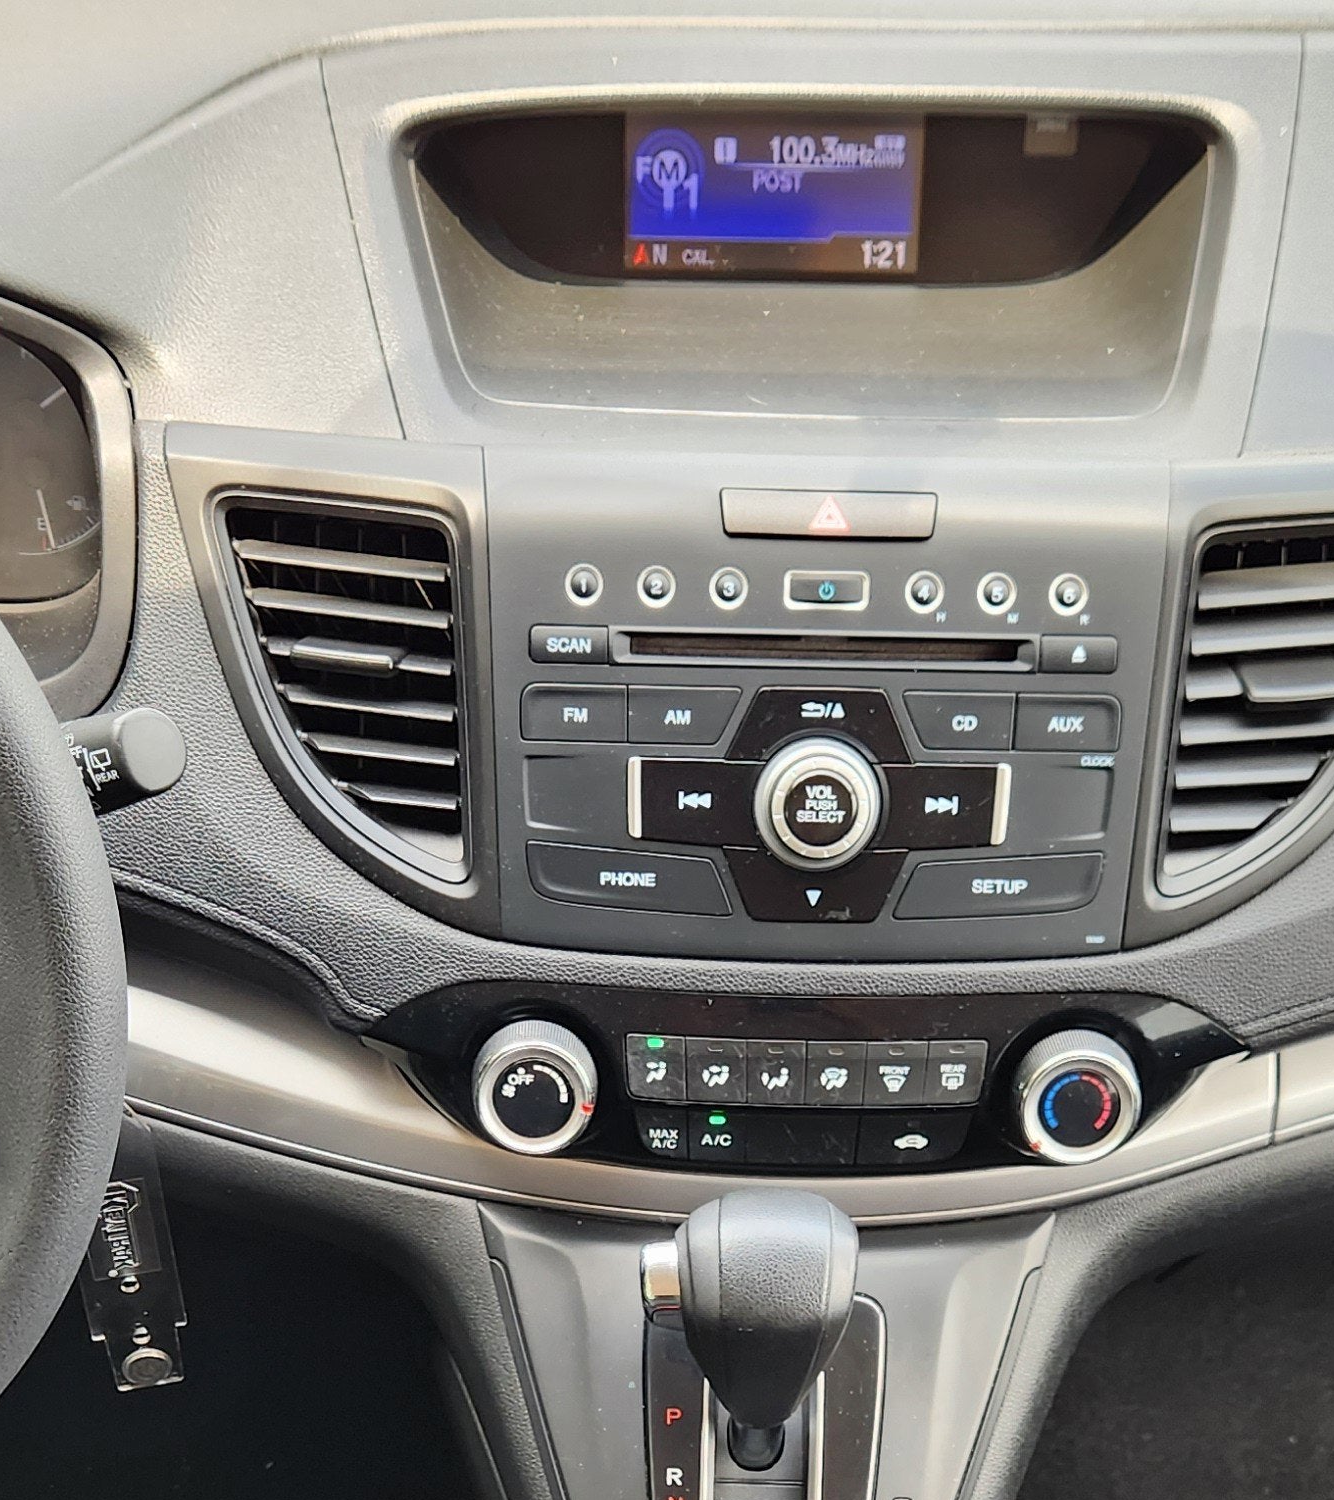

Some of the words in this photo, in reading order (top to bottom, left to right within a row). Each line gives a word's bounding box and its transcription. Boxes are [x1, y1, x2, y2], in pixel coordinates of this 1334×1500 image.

[753, 168, 804, 193] POST
[578, 579, 587, 593] 1
[650, 580, 663, 595] 2
[723, 581, 735, 596] 3
[917, 584, 930, 601] 4
[992, 586, 1004, 603] 5
[1063, 587, 1076, 604] 6
[546, 637, 592, 654] SCAN
[563, 707, 588, 723] FM
[664, 709, 691, 725] AM
[951, 715, 978, 731] CD
[1047, 716, 1085, 733] AUX
[94, 769, 120, 784] REAR
[805, 785, 837, 800] VOL
[805, 799, 838, 811] PUSH
[795, 810, 846, 824] SELECT
[600, 871, 656, 888] PHONE
[971, 878, 1028, 895] SETUP
[878, 1065, 911, 1075] FRONT
[940, 1063, 967, 1074] REAR
[507, 1074, 535, 1086] OFF
[648, 1128, 678, 1139] MAX
[700, 1134, 733, 1148] A/C
[651, 1138, 678, 1150] A/C
[666, 1408, 683, 1426] P
[666, 1467, 684, 1486] R
